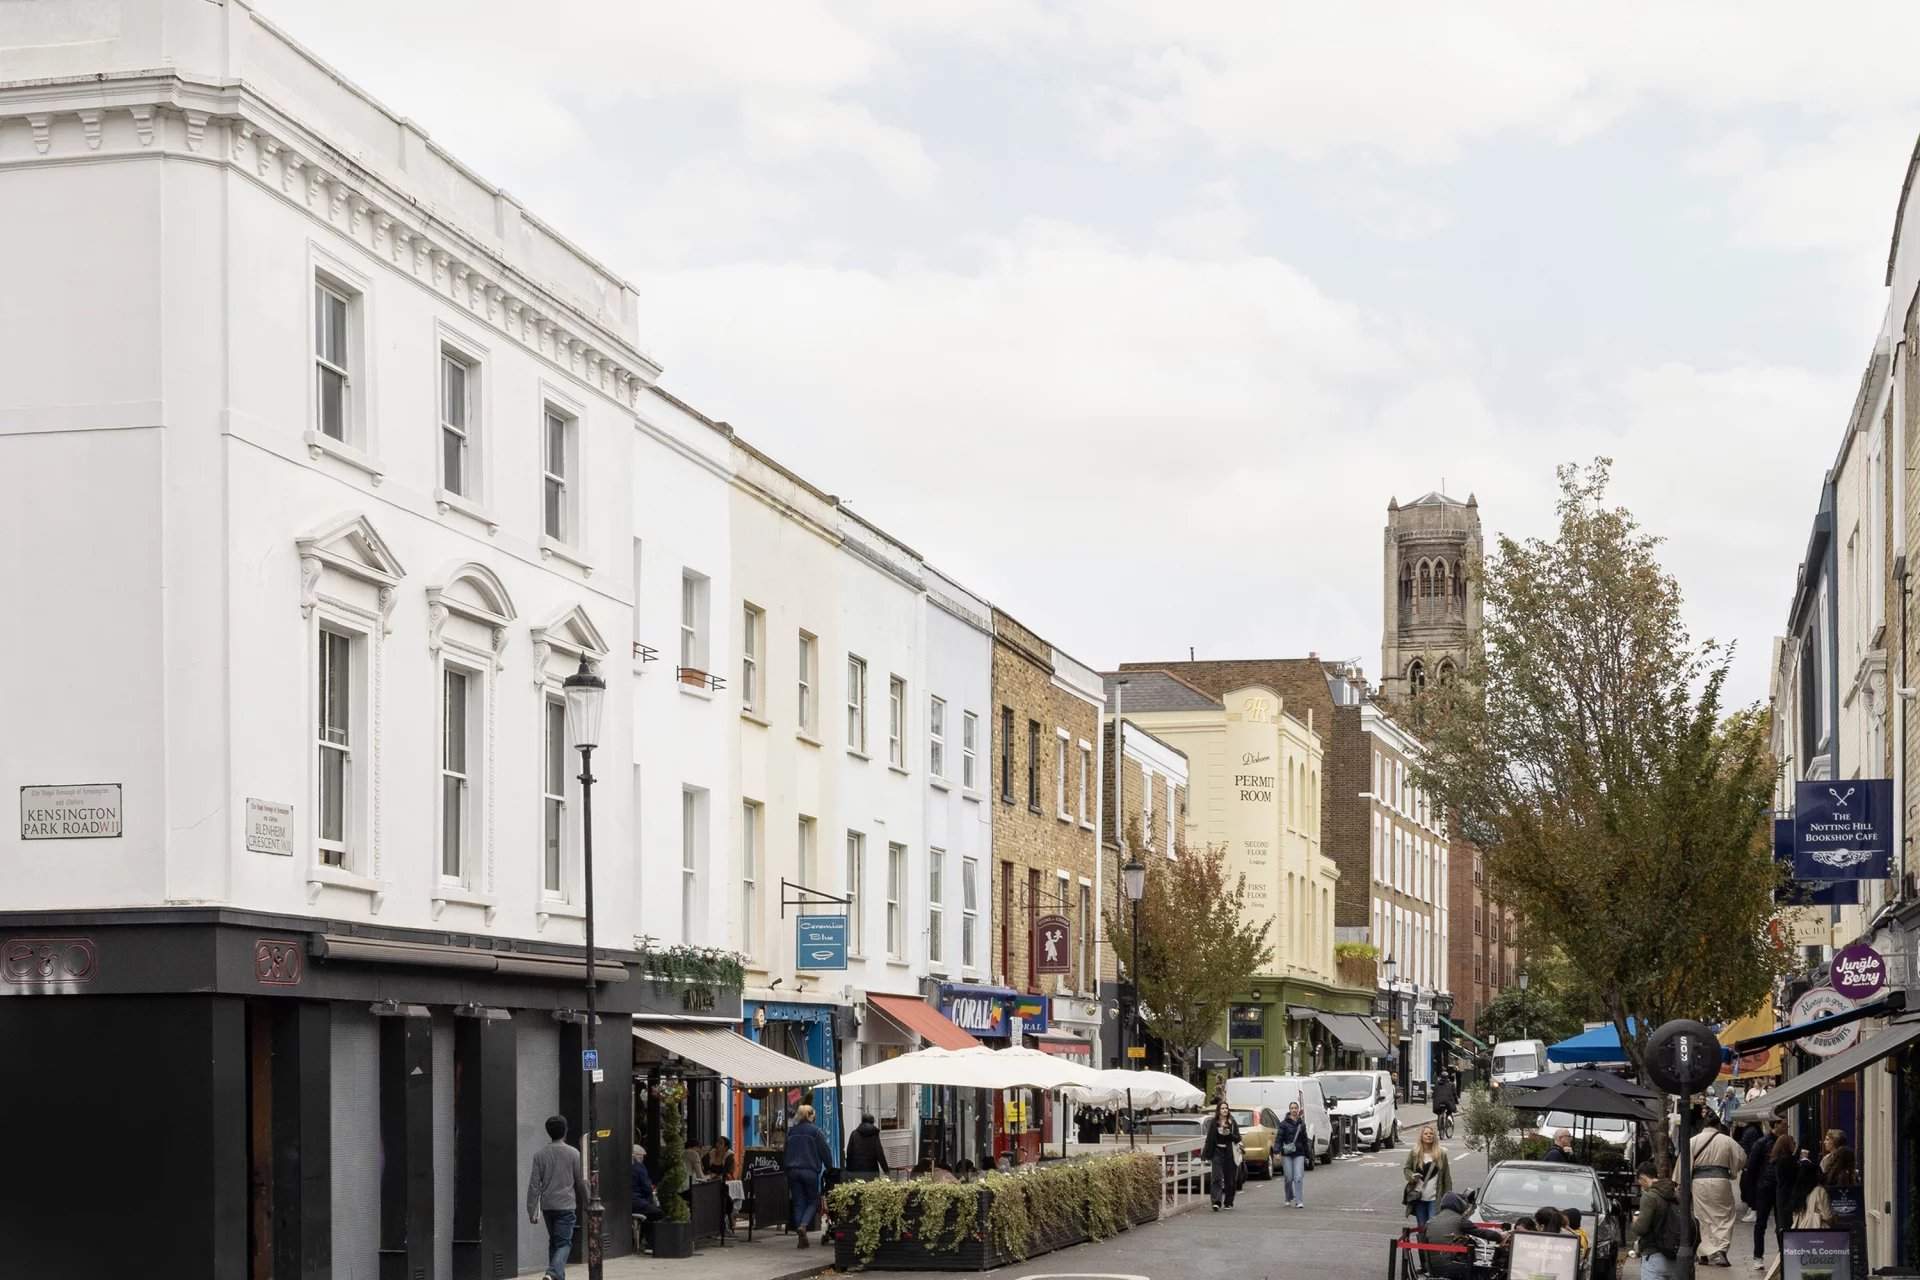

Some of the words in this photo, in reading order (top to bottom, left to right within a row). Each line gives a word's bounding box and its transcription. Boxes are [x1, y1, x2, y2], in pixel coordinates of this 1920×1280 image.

[1235, 775, 1275, 788] PERMIT
[1240, 790, 1271, 802] ROOM
[27, 807, 116, 822] KENSINGTON
[1832, 812, 1851, 821] THE
[23, 822, 58, 835] PARK
[62, 821, 100, 834] ROAD
[255, 822, 286, 839] BLENHEIM
[1810, 823, 1851, 832] NOTTING
[1852, 822, 1873, 831] HILL
[1805, 833, 1854, 842] BOOKSHOP
[809, 933, 834, 941] Blue
[1836, 956, 1879, 973] Jungle
[1842, 971, 1880, 986] Berry
[952, 998, 992, 1030] CORAL
[1819, 1248, 1850, 1256] Coconut
